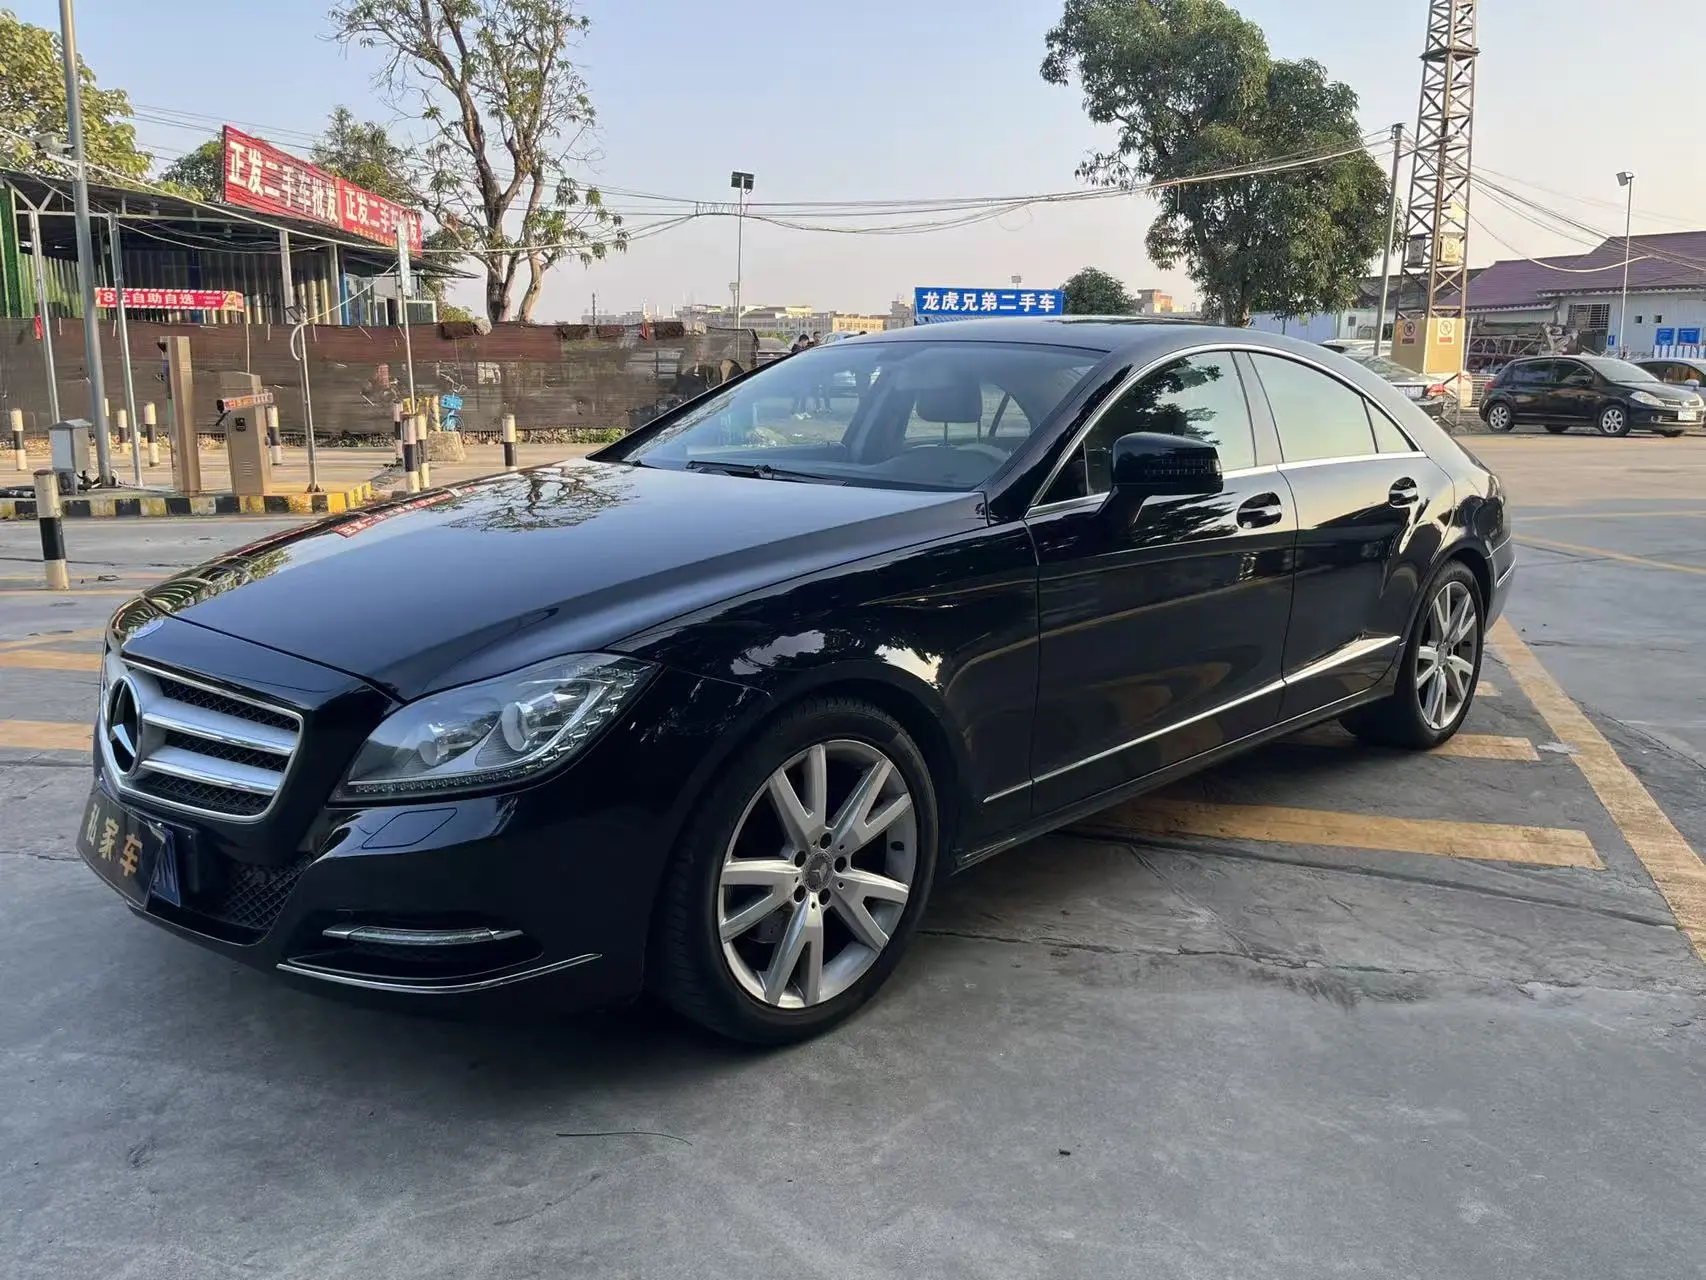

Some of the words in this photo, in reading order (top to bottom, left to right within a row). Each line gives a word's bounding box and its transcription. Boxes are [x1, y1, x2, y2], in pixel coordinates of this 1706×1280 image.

[228, 140, 338, 223] 正发二手车批发
[103, 291, 195, 305] 8元自助自选
[922, 291, 1056, 313] 龙虎兄弟二手车
[86, 803, 143, 877] 私家车
